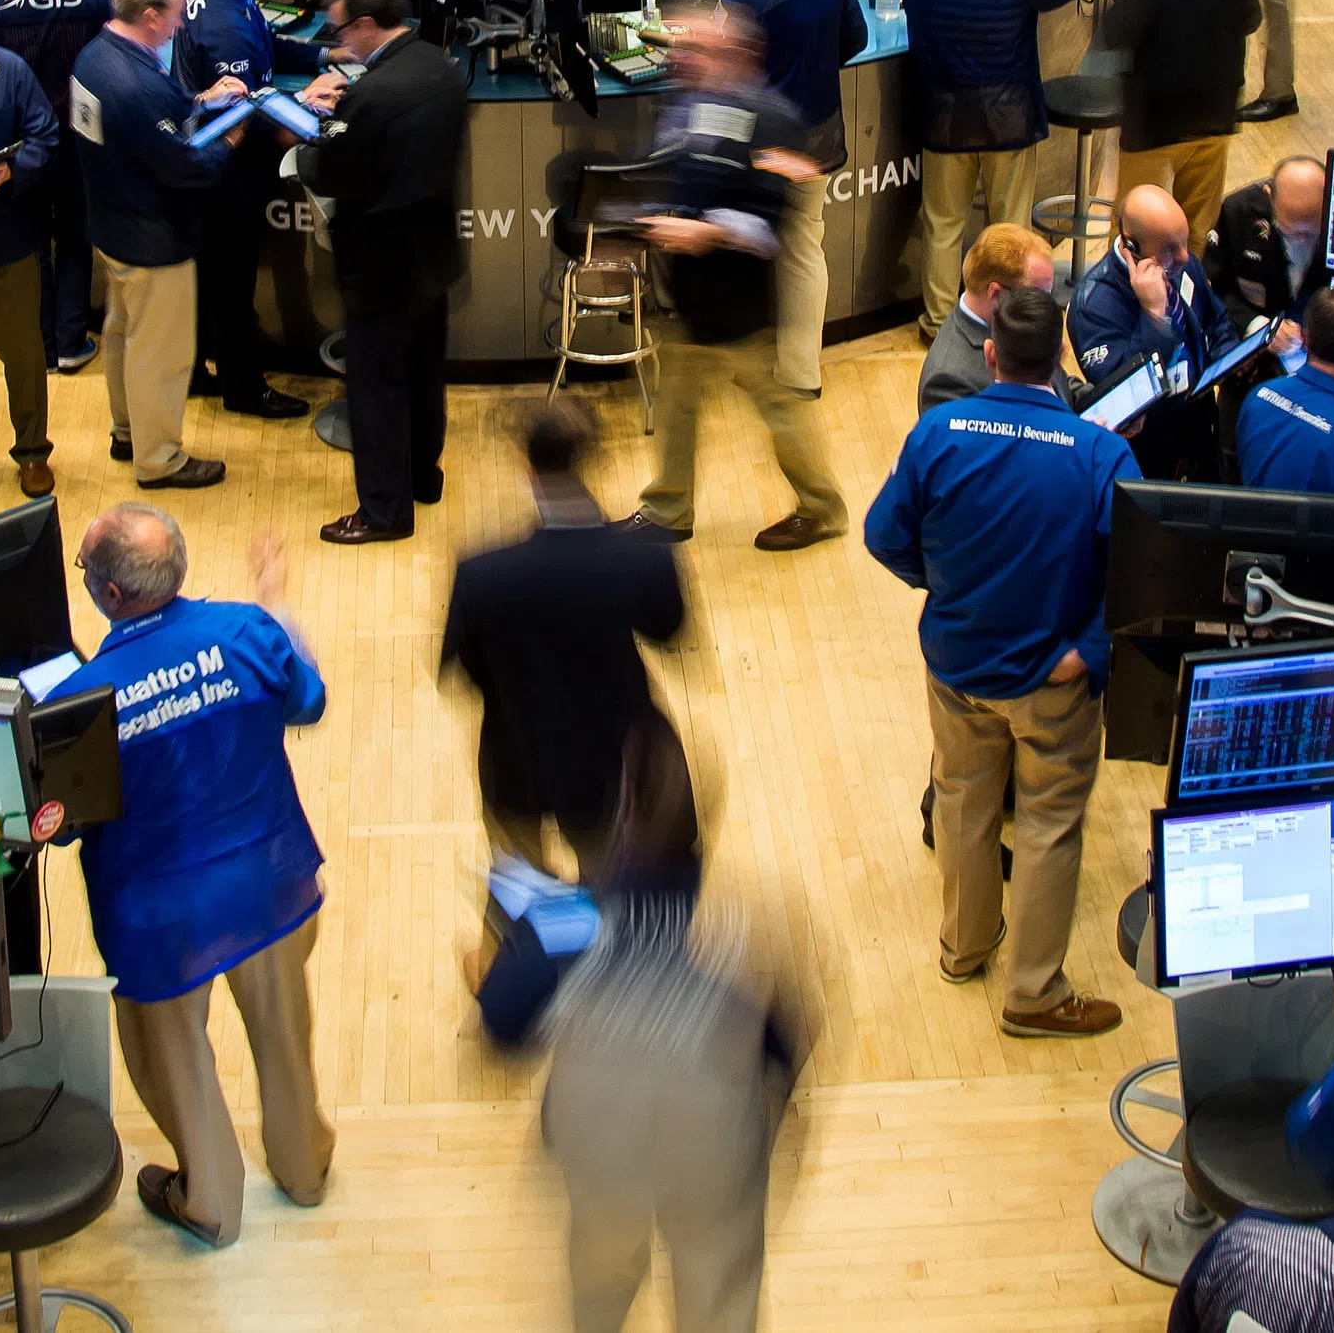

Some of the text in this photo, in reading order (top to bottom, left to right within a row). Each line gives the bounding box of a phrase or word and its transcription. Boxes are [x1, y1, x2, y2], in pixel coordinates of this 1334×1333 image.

[966, 419, 1075, 447] CITADEL Securities
[116, 644, 224, 712] uattro M
[118, 690, 201, 742] ecurities
